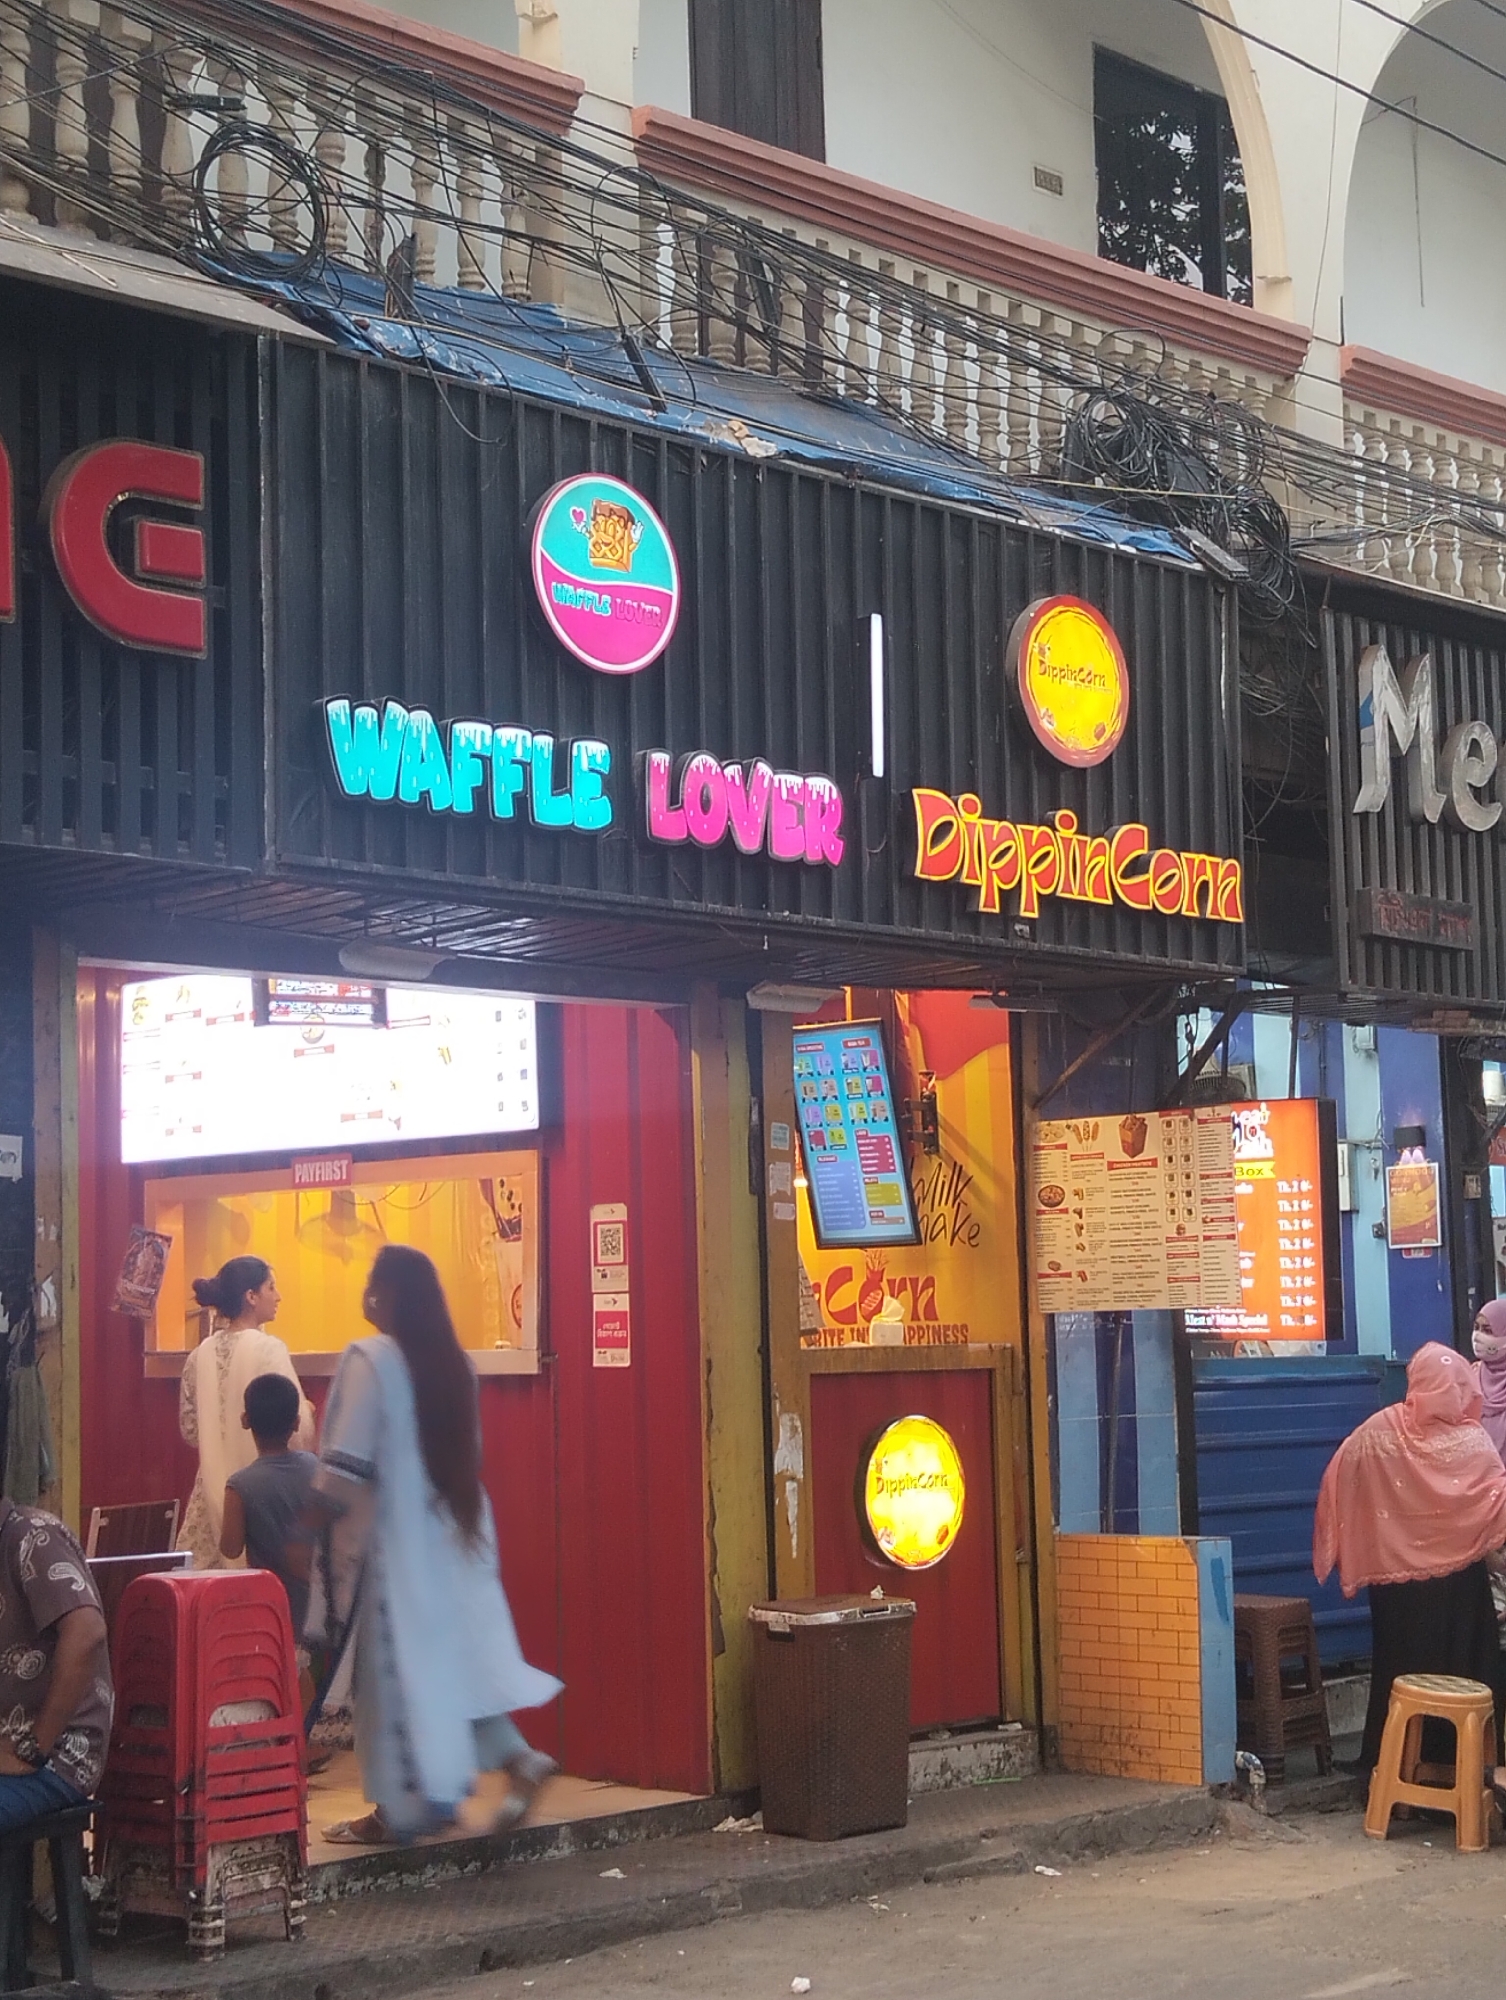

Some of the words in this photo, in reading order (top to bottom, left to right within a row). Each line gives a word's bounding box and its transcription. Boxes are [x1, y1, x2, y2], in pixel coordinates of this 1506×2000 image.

[551, 580, 612, 617] WAFFLE
[614, 597, 664, 629] LOVER
[1038, 658, 1106, 687] DippinCorn
[323, 695, 613, 832] WAFFLE
[647, 748, 845, 868] LOVER
[911, 787, 1245, 924] DippinCorn
[876, 1473, 948, 1497] DippinCorn
